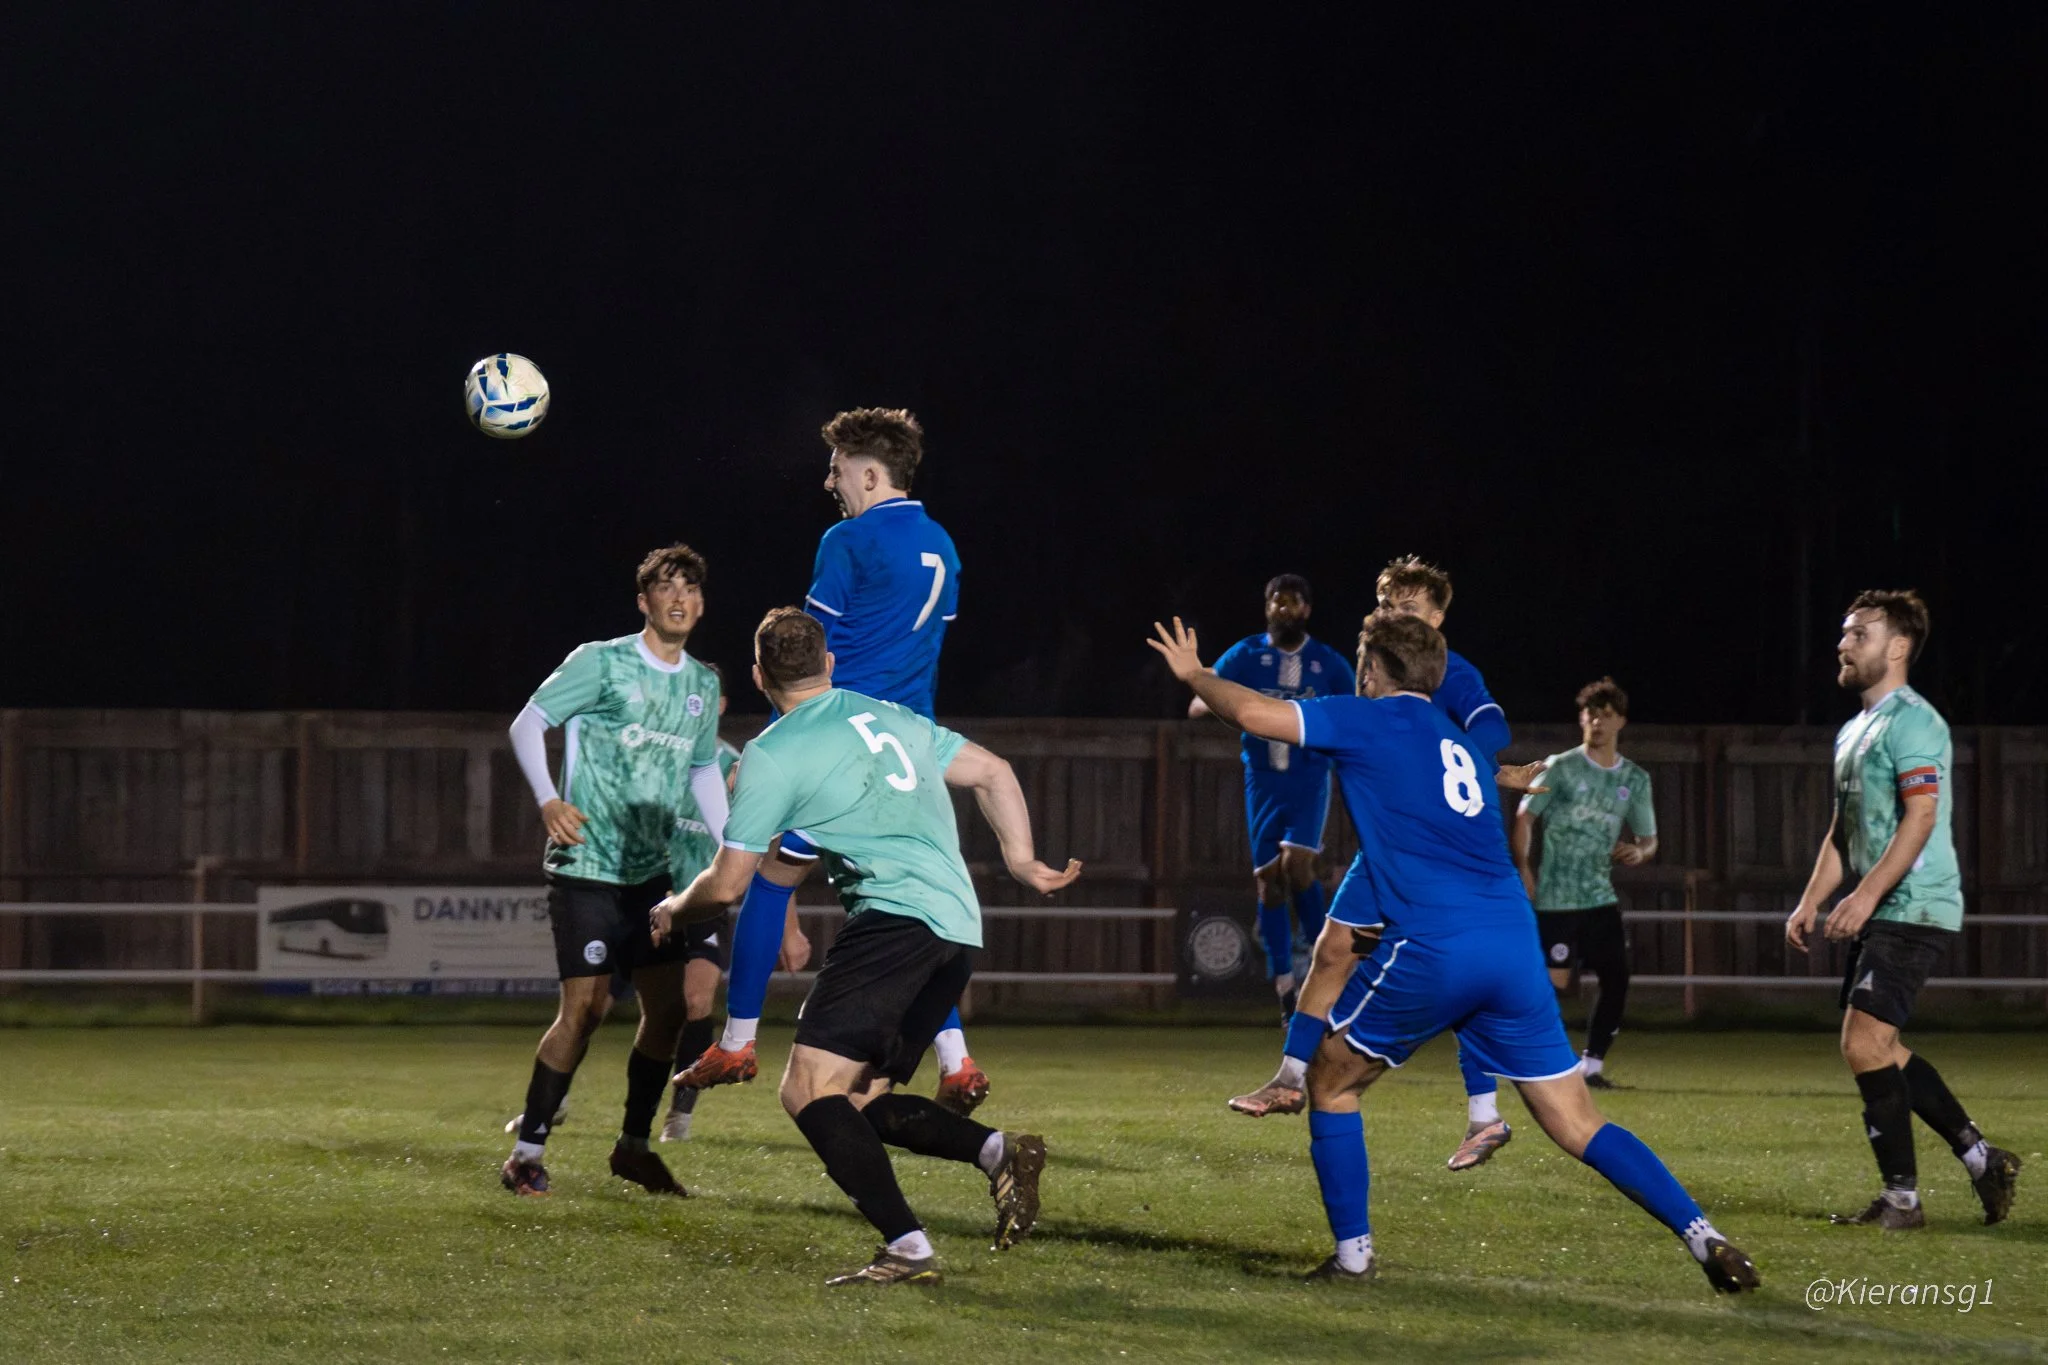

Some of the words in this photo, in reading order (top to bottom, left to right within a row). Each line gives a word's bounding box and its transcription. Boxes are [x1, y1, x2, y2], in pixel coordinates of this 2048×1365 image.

[912, 552, 946, 632] 7
[847, 712, 917, 791] 5
[1440, 738, 1485, 817] 8
